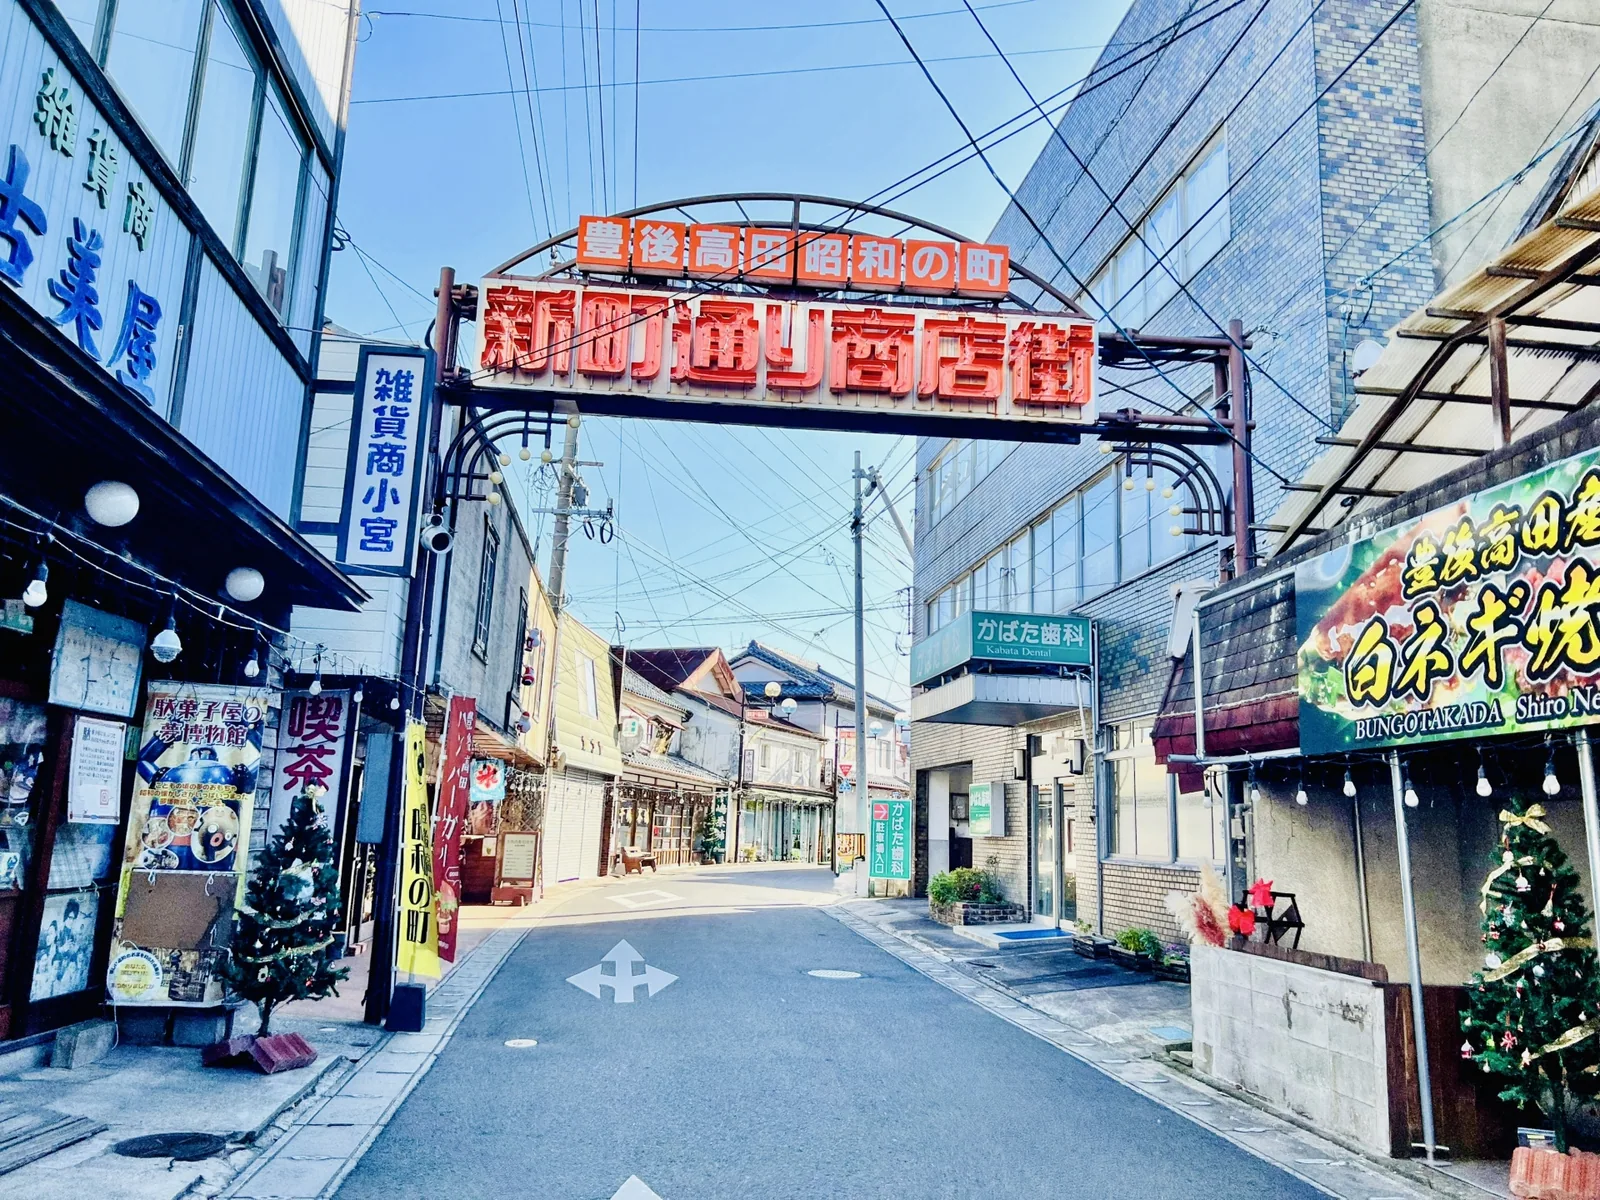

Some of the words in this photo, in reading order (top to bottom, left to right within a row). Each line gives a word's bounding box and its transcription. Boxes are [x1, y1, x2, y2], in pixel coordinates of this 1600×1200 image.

[34, 67, 154, 252] 雑貨商
[582, 220, 1005, 287] 豊後高田昭和の町
[480, 285, 1095, 405] 新町通り商店街
[360, 367, 415, 553] 雑貨商小宮
[977, 618, 1084, 647] かばた歯科
[986, 644, 1019, 656] Kabata
[1022, 645, 1051, 657] Dental
[153, 698, 262, 723] 駄菓子屋の
[157, 722, 249, 747] 夢博物館
[283, 695, 343, 792] 喫茶
[1354, 700, 1502, 740] BUNGOTAKADA
[1516, 694, 1566, 720] Shiro
[891, 803, 905, 876] かばた歯科
